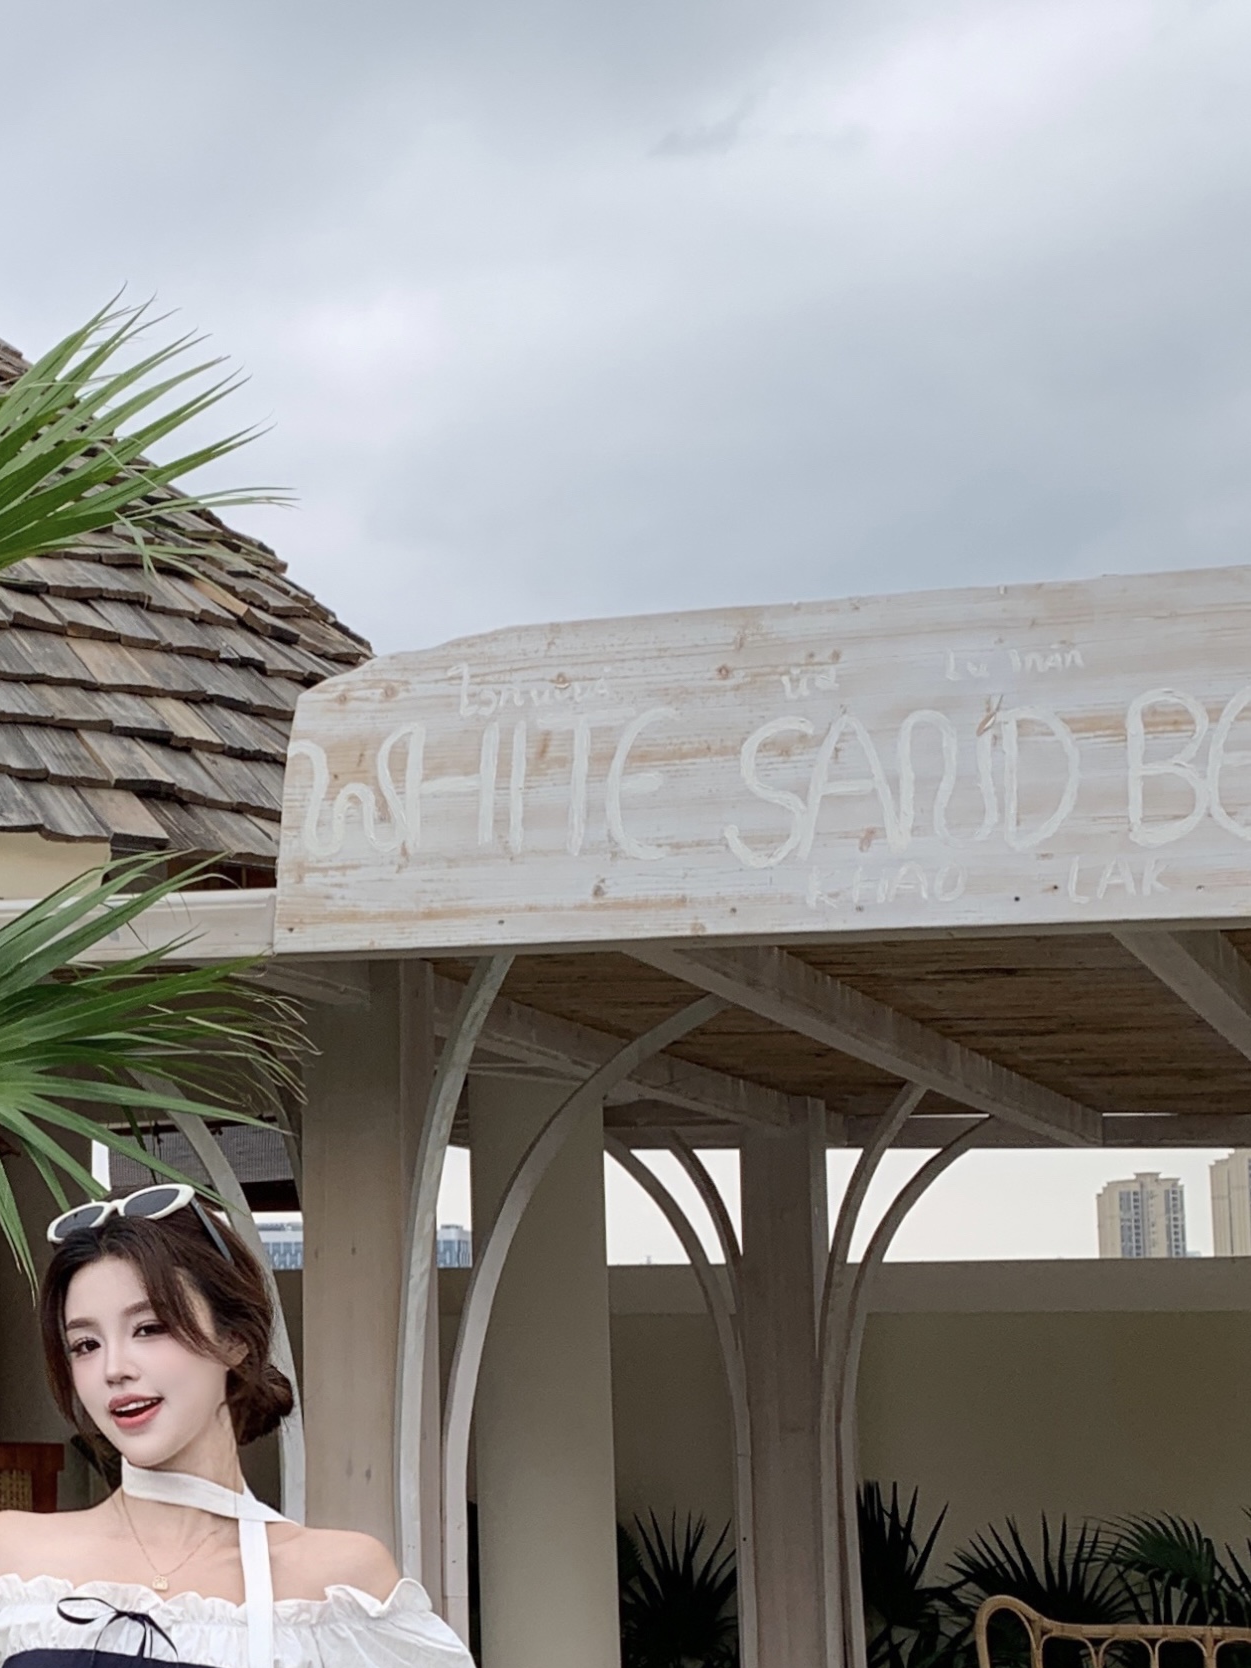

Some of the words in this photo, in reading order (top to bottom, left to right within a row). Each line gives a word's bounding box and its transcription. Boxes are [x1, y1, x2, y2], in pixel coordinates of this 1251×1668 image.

[286, 705, 680, 861] WHITE
[724, 702, 1080, 869] SAND
[804, 859, 967, 910] KHAO
[1068, 854, 1171, 904] LAK
